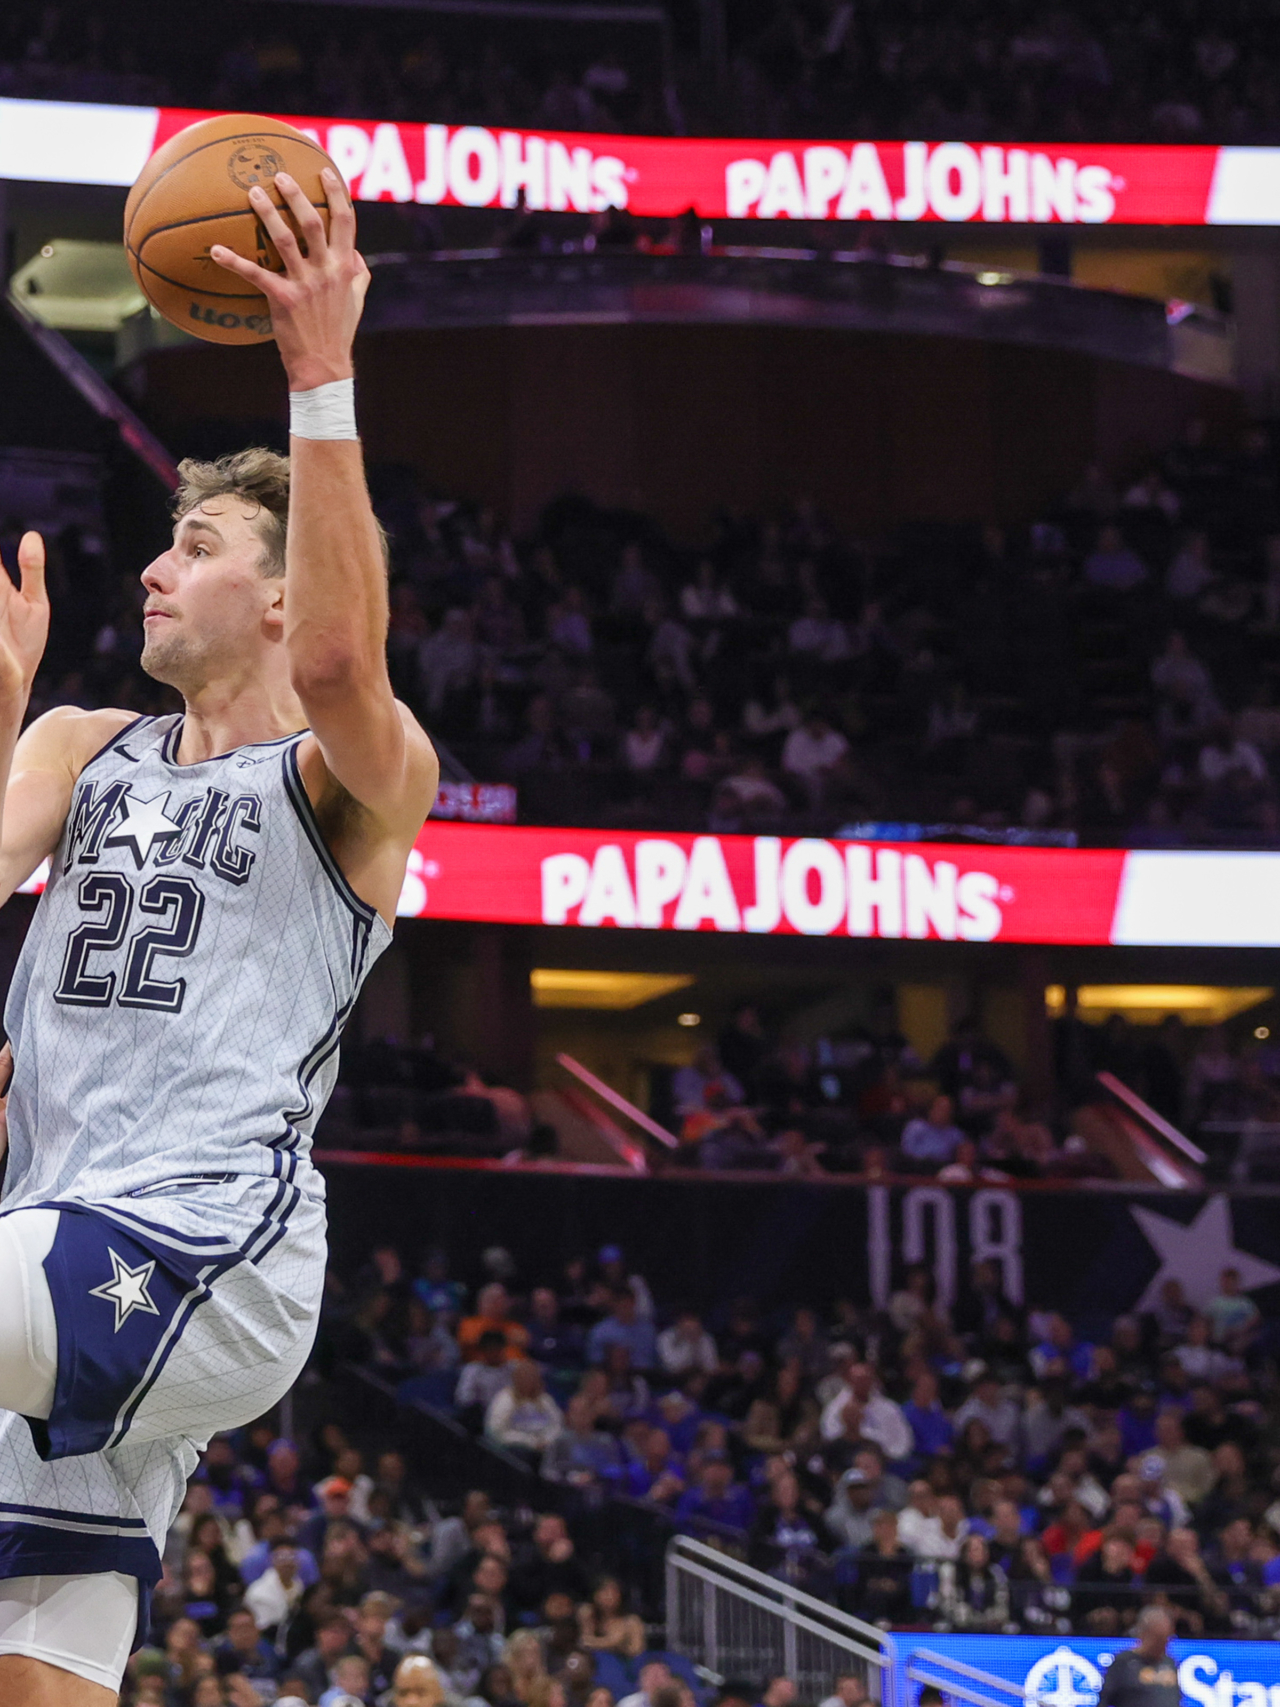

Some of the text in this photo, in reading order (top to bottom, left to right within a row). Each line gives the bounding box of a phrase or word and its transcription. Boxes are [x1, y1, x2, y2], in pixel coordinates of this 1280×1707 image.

[64, 779, 262, 886] MGIC
[53, 871, 206, 1013] 22
[1177, 1654, 1280, 1707] Sta
